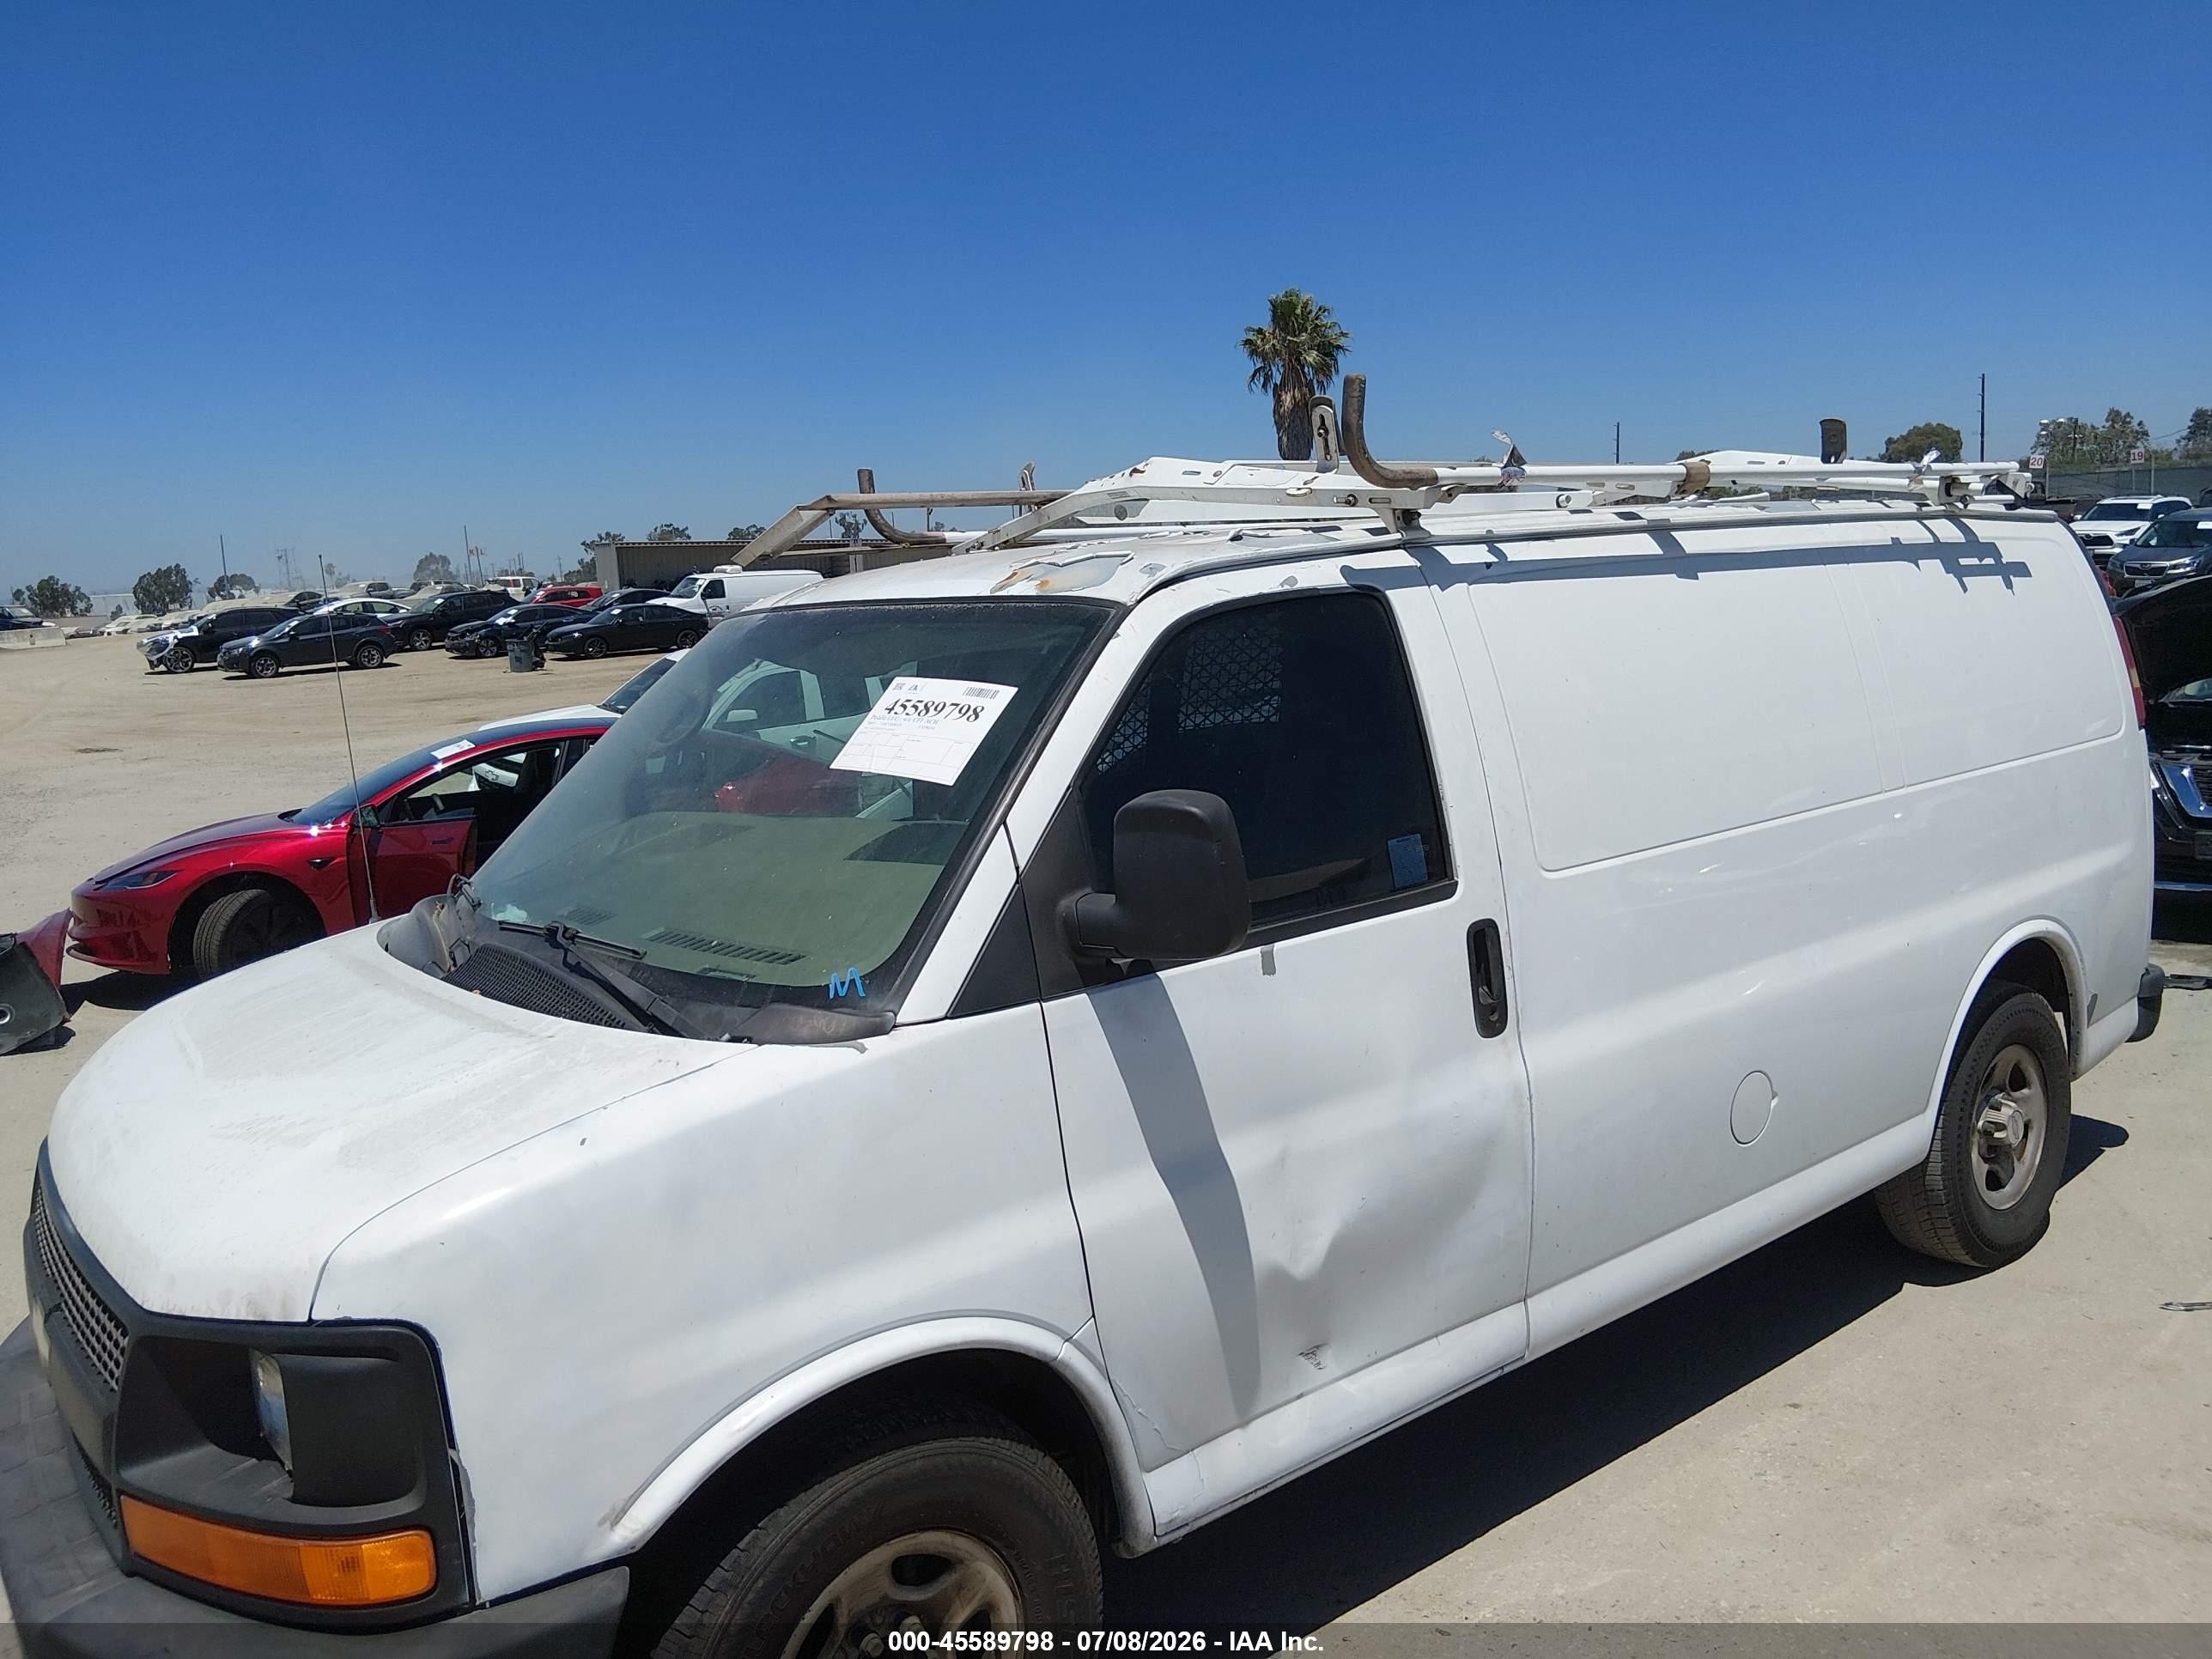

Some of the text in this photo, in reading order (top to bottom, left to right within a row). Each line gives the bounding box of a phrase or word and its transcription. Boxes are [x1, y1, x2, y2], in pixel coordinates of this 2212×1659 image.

[2031, 456, 2042, 466] 20
[2131, 451, 2142, 461] 19
[884, 698, 985, 722] 45589798
[829, 967, 866, 1000] M
